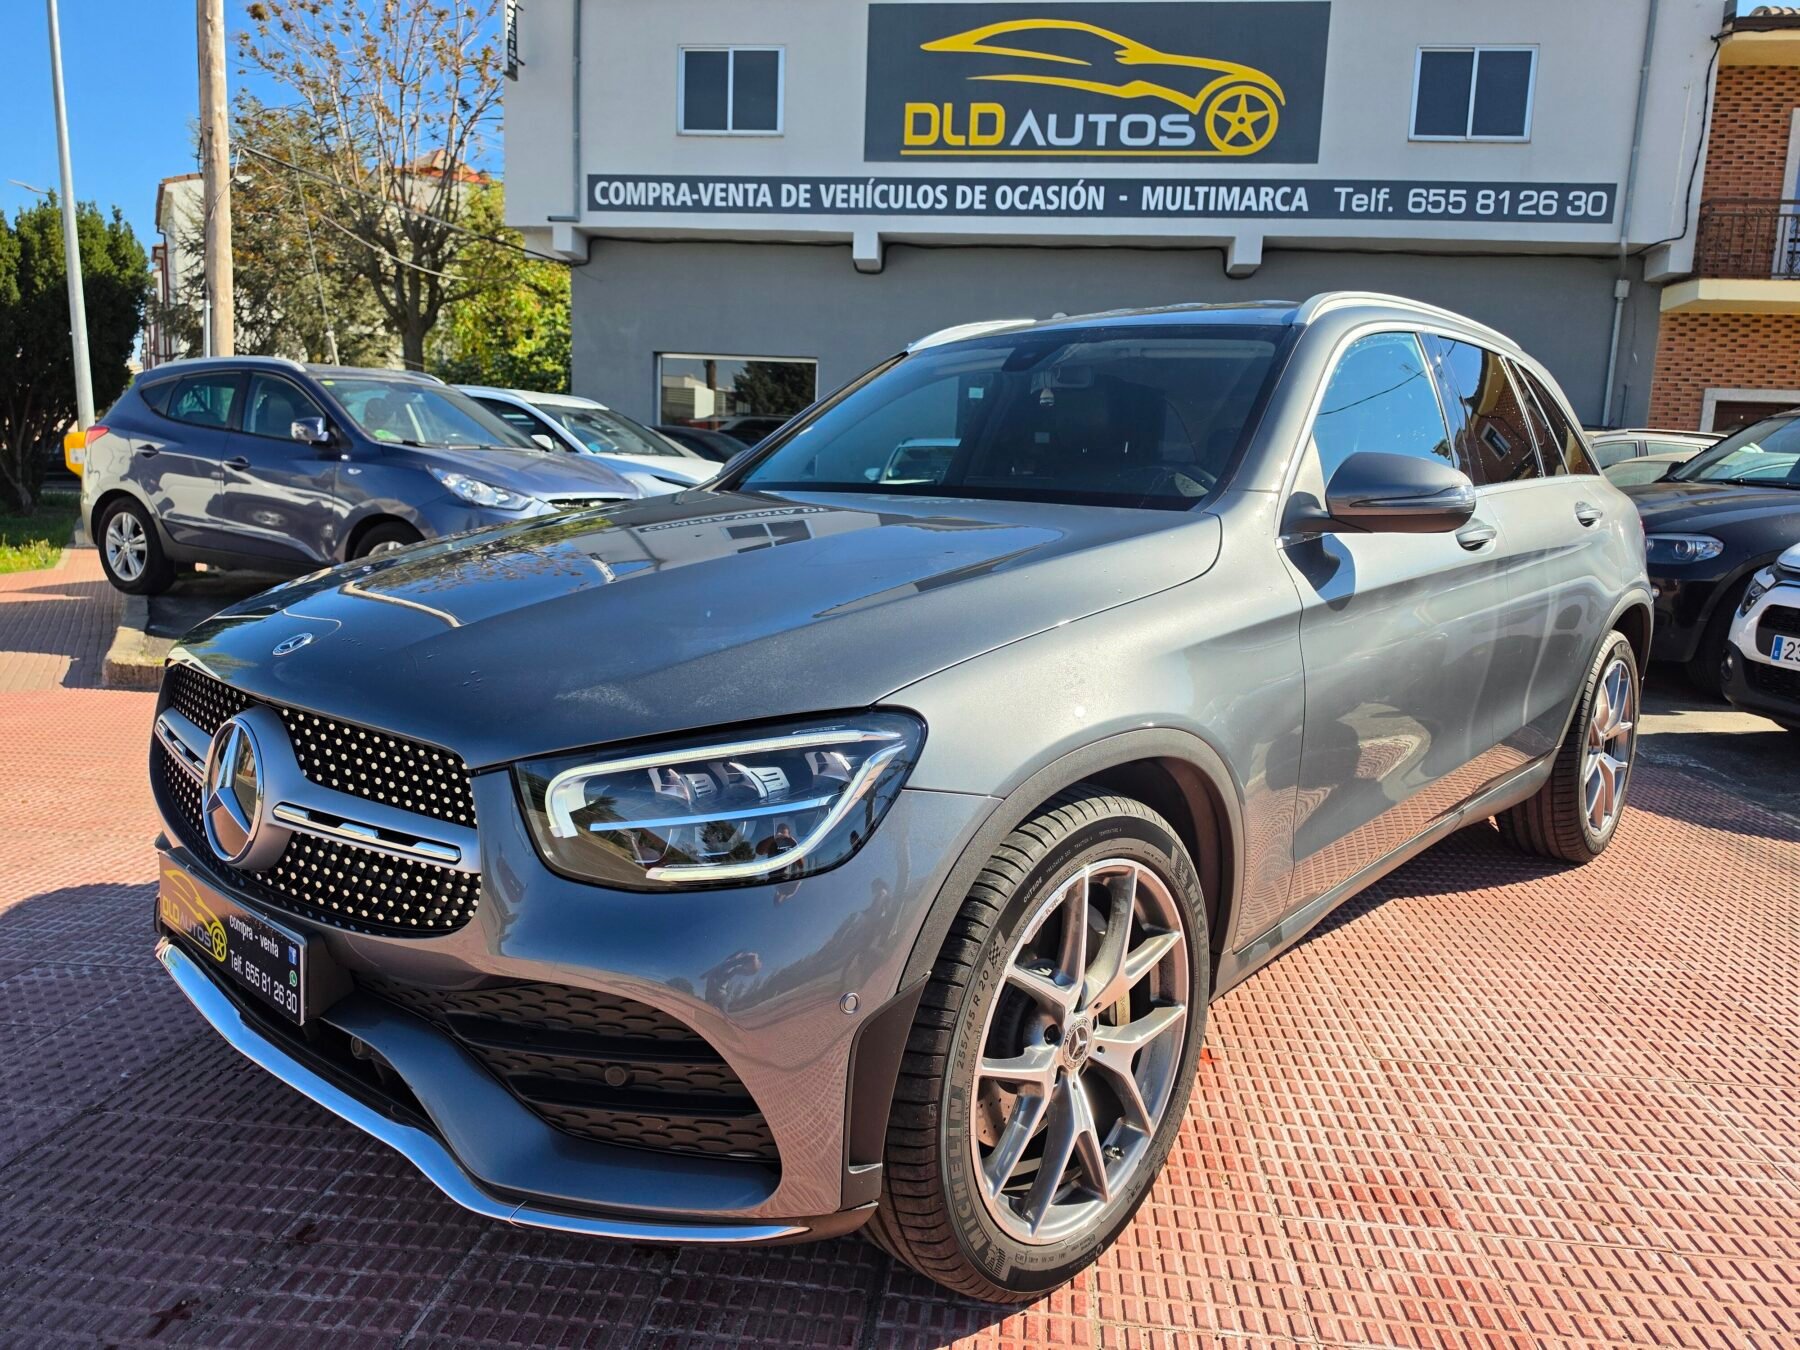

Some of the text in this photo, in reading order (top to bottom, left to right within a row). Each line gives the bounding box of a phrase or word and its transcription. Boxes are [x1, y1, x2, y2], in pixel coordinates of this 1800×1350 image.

[903, 102, 1197, 147] DLD AUTOS
[593, 180, 774, 210] COMPRA-VENTA
[780, 182, 812, 209] DE
[818, 177, 949, 211] VEHÍCULOS
[955, 184, 988, 211] DE
[994, 179, 1106, 211] OCASIÓN
[1141, 185, 1310, 213] MULTIMARCA
[1334, 186, 1394, 213] Telf.
[1407, 187, 1467, 215] 655
[1566, 191, 1609, 217] 30
[162, 896, 212, 948] DLD AUTOS
[229, 914, 254, 941] compra
[260, 934, 279, 958] venta
[245, 960, 260, 988] 655
[261, 971, 271, 996] 81
[273, 980, 285, 1005] 26
[286, 990, 298, 1015] 30
[956, 1010, 976, 1070] 255/45
[948, 1096, 988, 1252] MICHELIN
